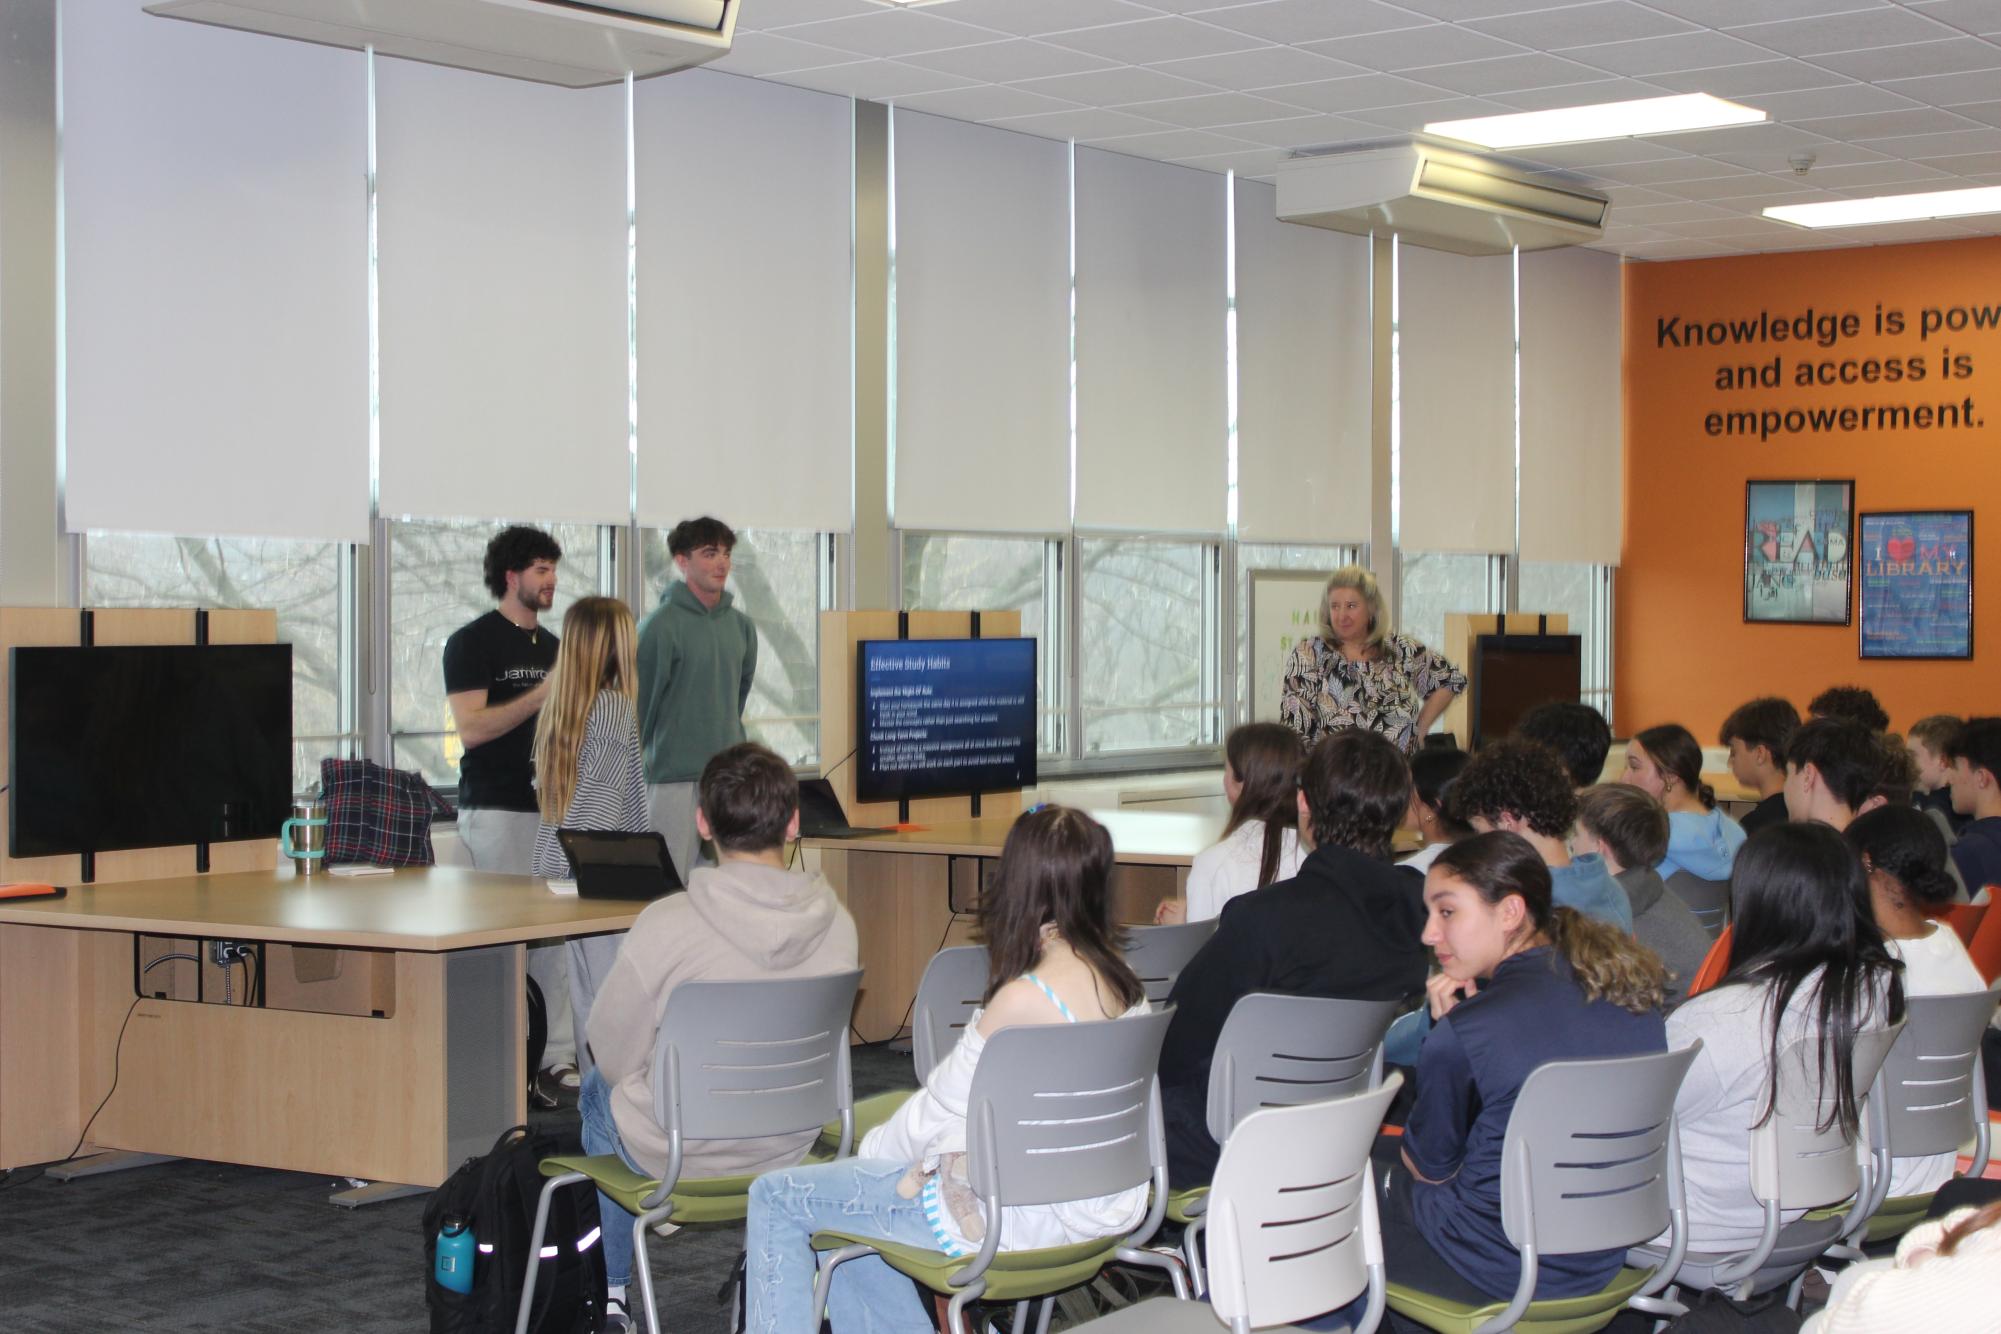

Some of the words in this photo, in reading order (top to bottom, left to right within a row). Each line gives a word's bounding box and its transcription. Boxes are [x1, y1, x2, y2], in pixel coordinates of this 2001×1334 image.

[1657, 307, 1860, 349] Knowledge
[1874, 301, 1906, 337] is
[1714, 356, 1782, 390] and
[1794, 356, 1927, 387] access
[1941, 346, 1974, 380] is
[1703, 394, 1985, 442] empowerment.
[1866, 558, 1967, 577] LIBRARY
[871, 656, 903, 671] Effective
[904, 655, 926, 673] Study
[927, 655, 950, 671] Habits
